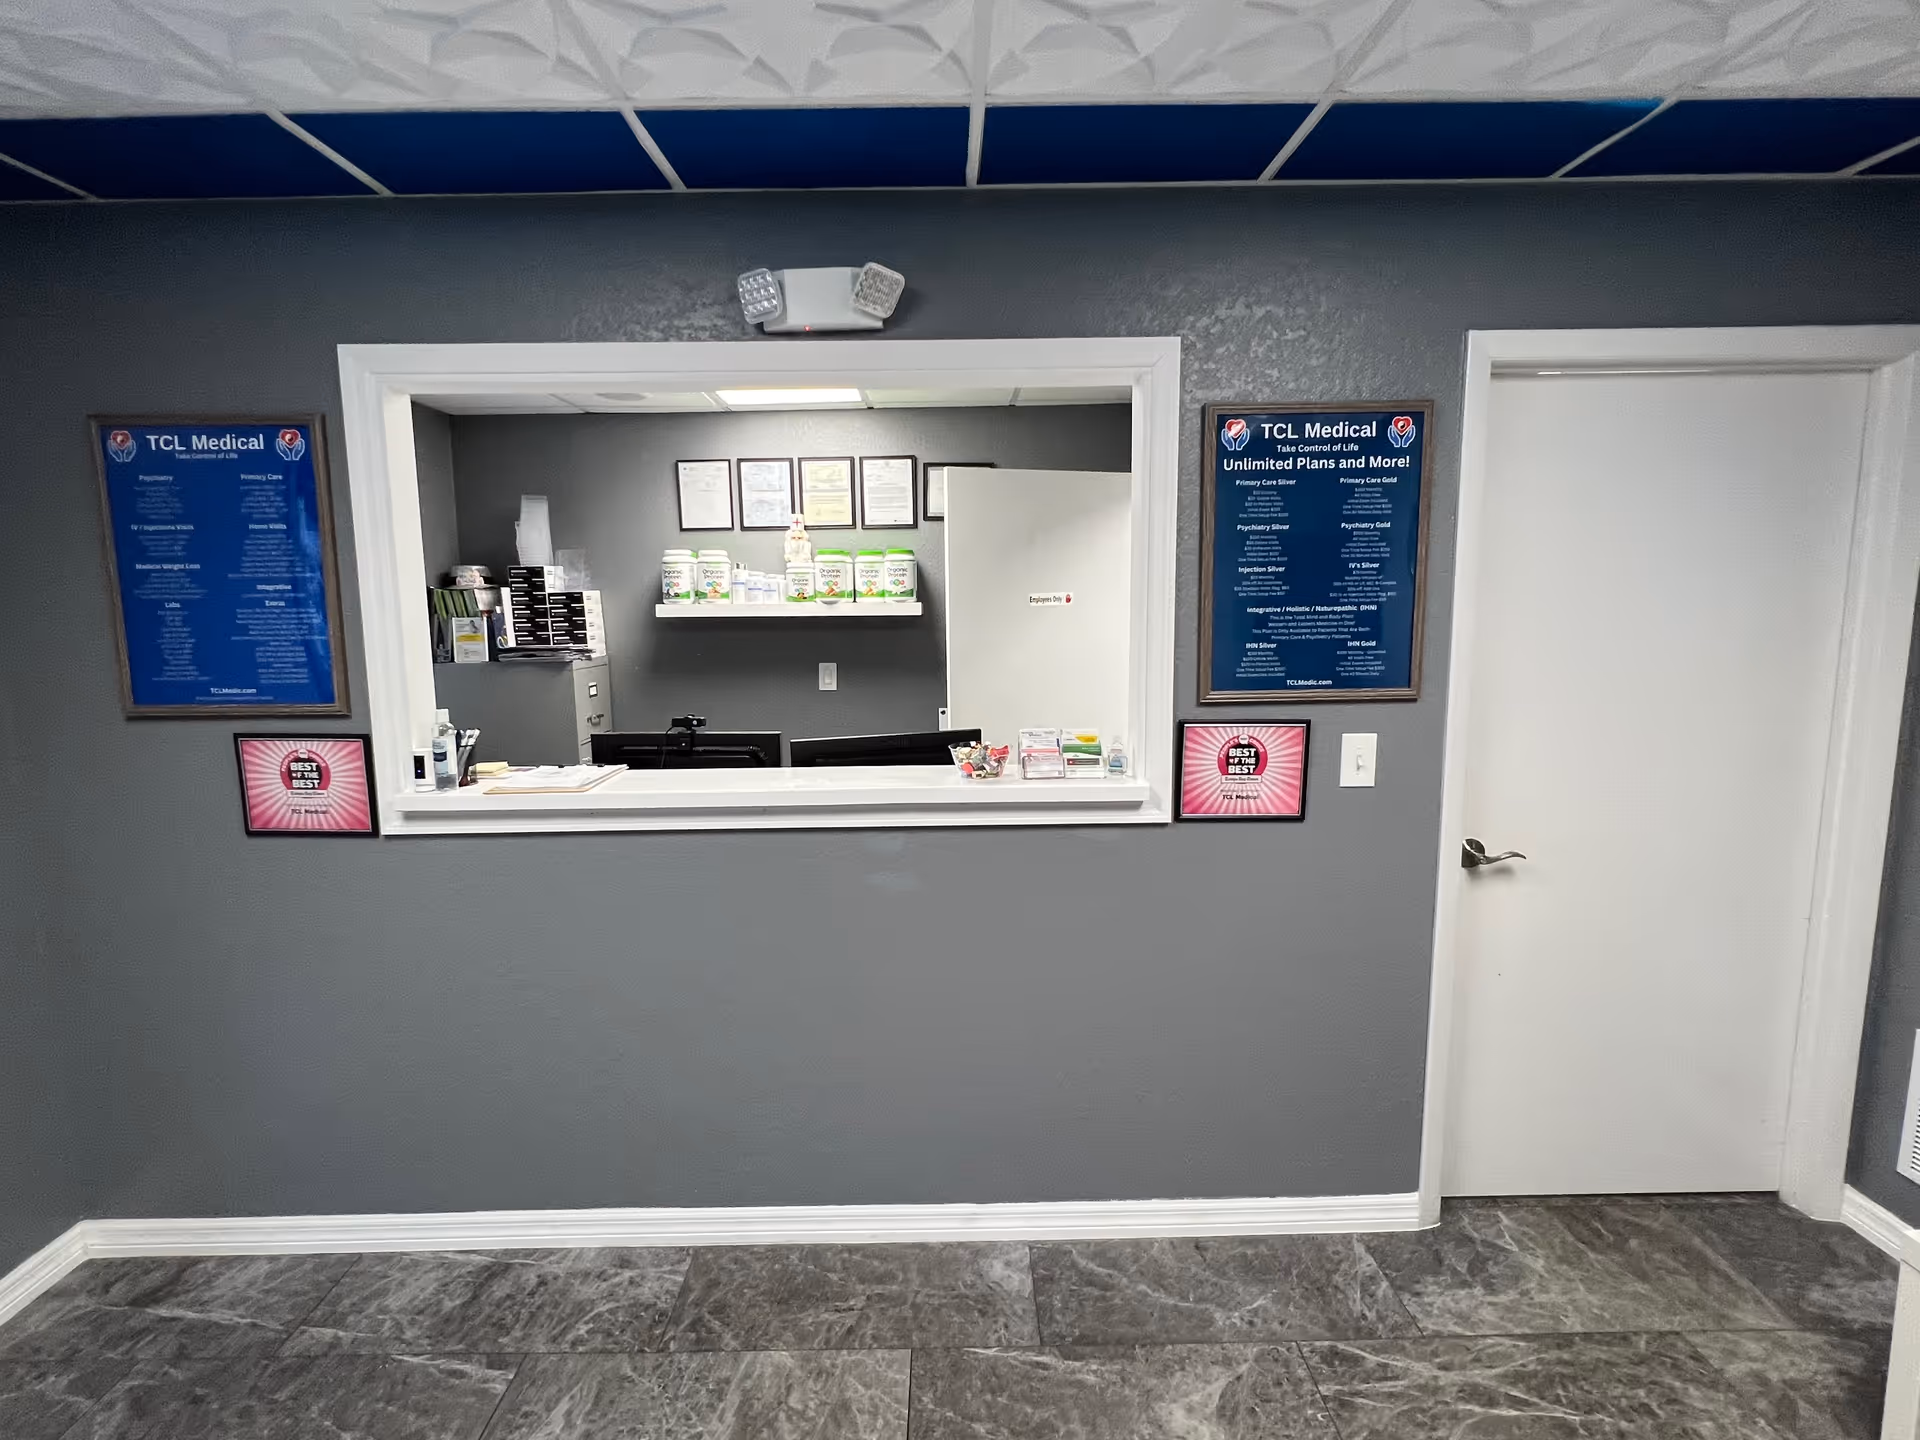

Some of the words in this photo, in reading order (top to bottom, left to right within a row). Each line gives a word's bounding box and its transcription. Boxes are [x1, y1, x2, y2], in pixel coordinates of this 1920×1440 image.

[1261, 423, 1299, 439] TCL
[1304, 421, 1377, 439] Medical
[146, 435, 186, 451] TCL
[192, 433, 264, 450] Medical
[1277, 444, 1296, 453] Take
[1298, 444, 1331, 452] Control
[1332, 443, 1341, 452] of
[1343, 443, 1359, 451] Life
[1223, 458, 1293, 471] Unlimited
[1296, 457, 1335, 470] Plans
[1339, 456, 1366, 469] and
[1369, 456, 1410, 468] More!
[1236, 479, 1261, 487] Primary
[1237, 524, 1270, 532] Psychiatry
[1316, 605, 1357, 613] Naturopathic
[1229, 748, 1256, 757] BEST
[290, 762, 318, 771] BEST
[1228, 765, 1256, 774] BEST
[292, 780, 320, 788] BEST
